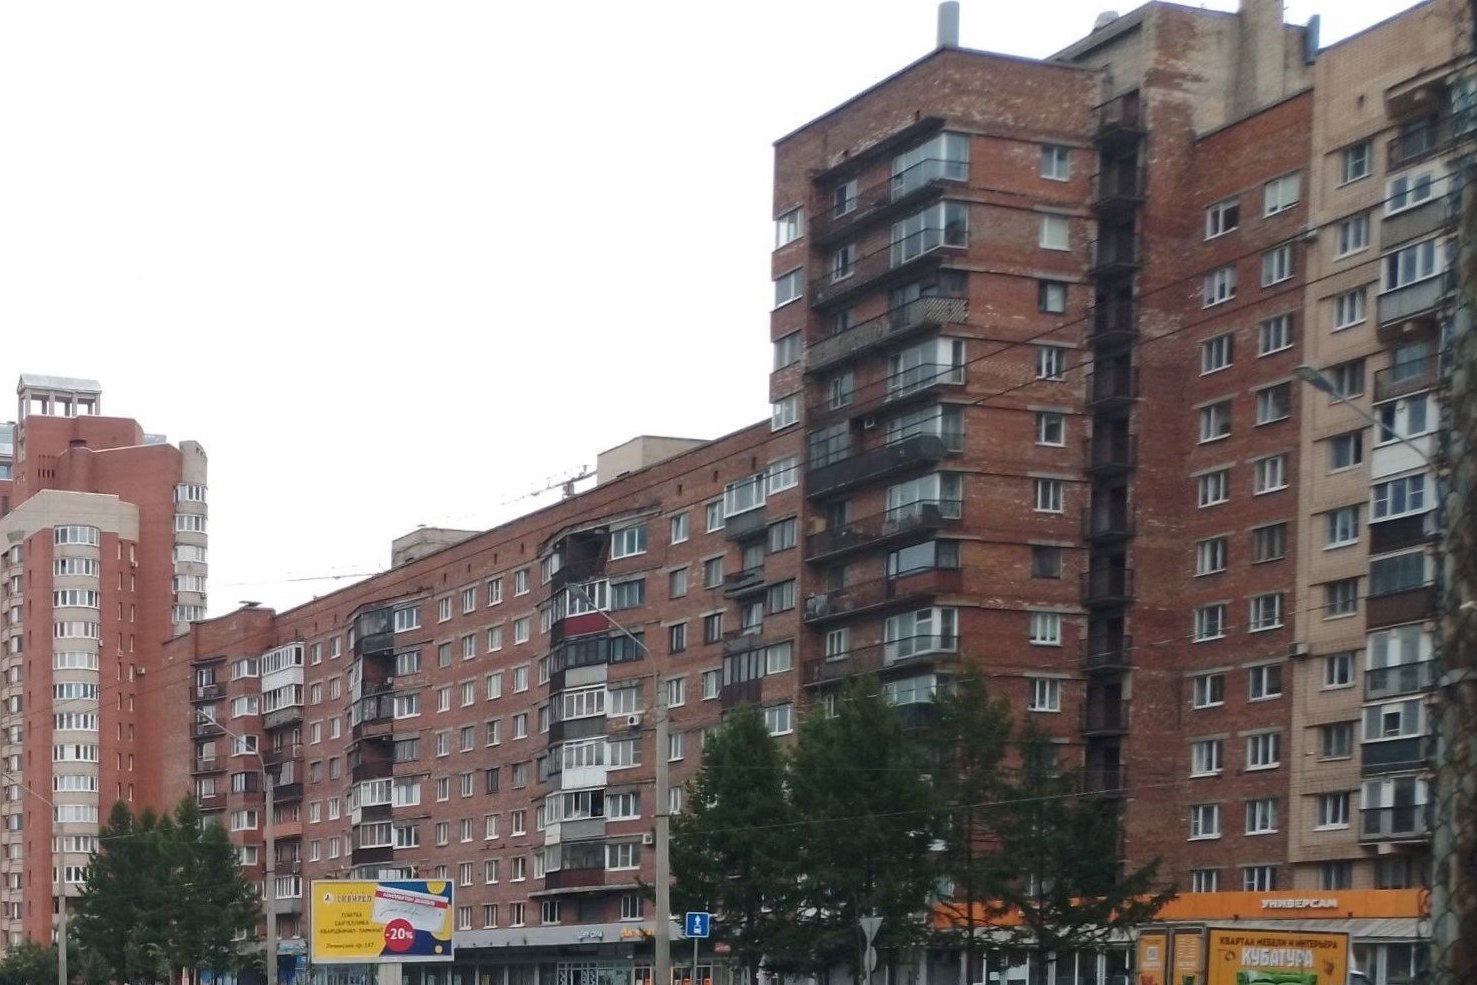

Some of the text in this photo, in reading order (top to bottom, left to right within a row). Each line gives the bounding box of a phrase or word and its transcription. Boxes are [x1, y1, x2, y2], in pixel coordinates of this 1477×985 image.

[1261, 898, 1338, 909] УНИВЕРСАМ
[385, 928, 414, 940] -20%
[1219, 936, 1255, 946] КВАРТАЛ
[1241, 947, 1313, 968] КУБАТУРА
